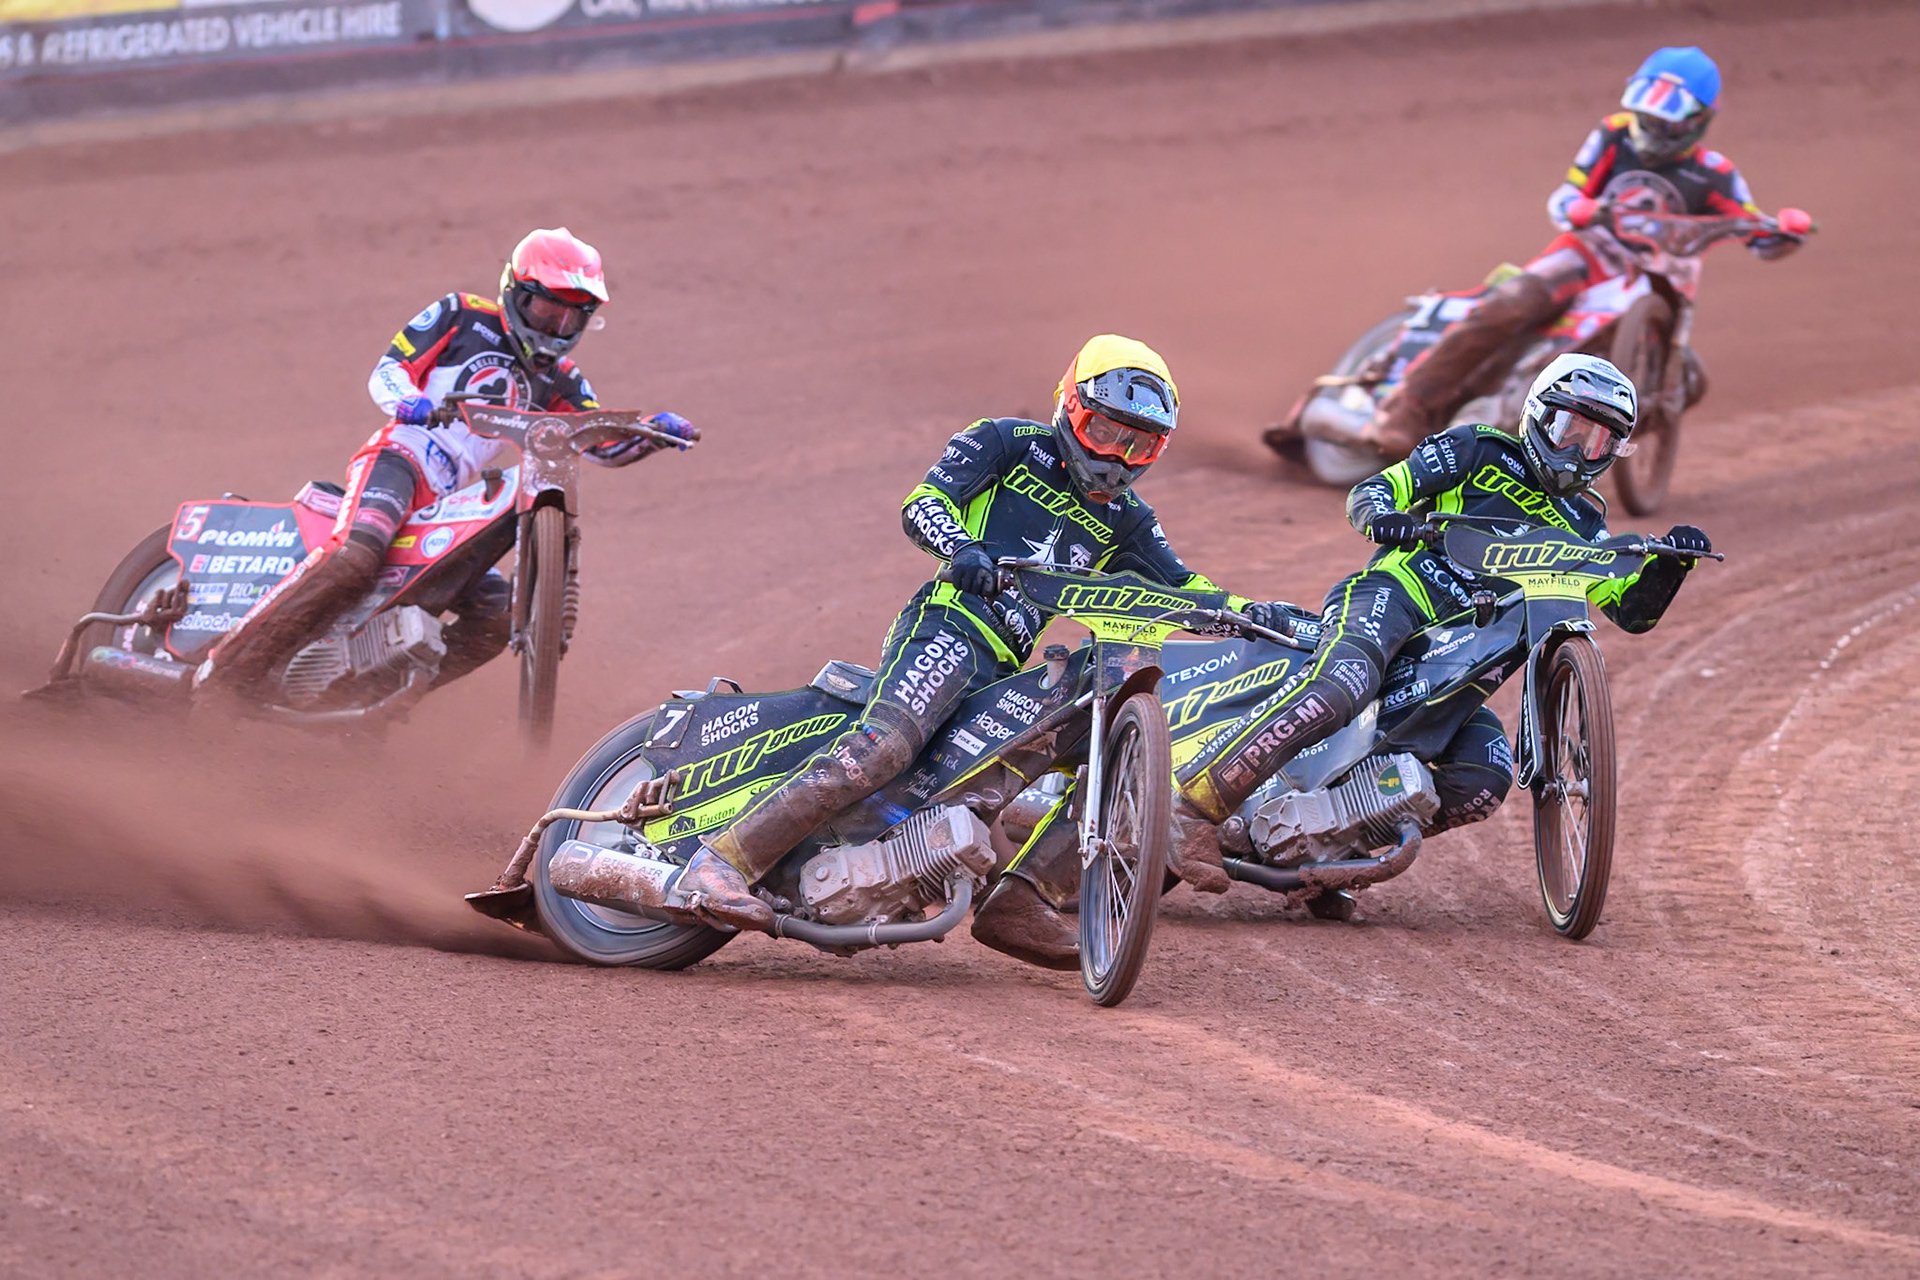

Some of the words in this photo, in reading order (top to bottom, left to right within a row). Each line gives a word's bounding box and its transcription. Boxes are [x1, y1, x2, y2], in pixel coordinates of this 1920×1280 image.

[42, 17, 230, 64] REFRIGERATED
[232, 6, 340, 47] VEHICLE
[341, 1, 402, 38] HIRE
[469, 356, 499, 373] BELLE
[175, 506, 211, 540] 5
[907, 504, 954, 556] SHOCKS
[919, 496, 971, 541] HAGON
[207, 555, 296, 575] BETARD
[1528, 577, 1581, 588] MAYFIELD
[1371, 586, 1393, 619] TEXOM
[894, 629, 956, 704] HAGON
[911, 641, 969, 716] SHOCKS
[1167, 650, 1239, 685] TEXOM
[1339, 664, 1366, 696] Building
[996, 697, 1035, 725] SHOCKS
[1003, 688, 1043, 714] HAGON
[652, 709, 687, 741] 7
[701, 701, 760, 736] HAGON
[701, 712, 760, 747] SHOCKS
[1243, 697, 1325, 768] PRG-M
[698, 806, 736, 828] Euston
